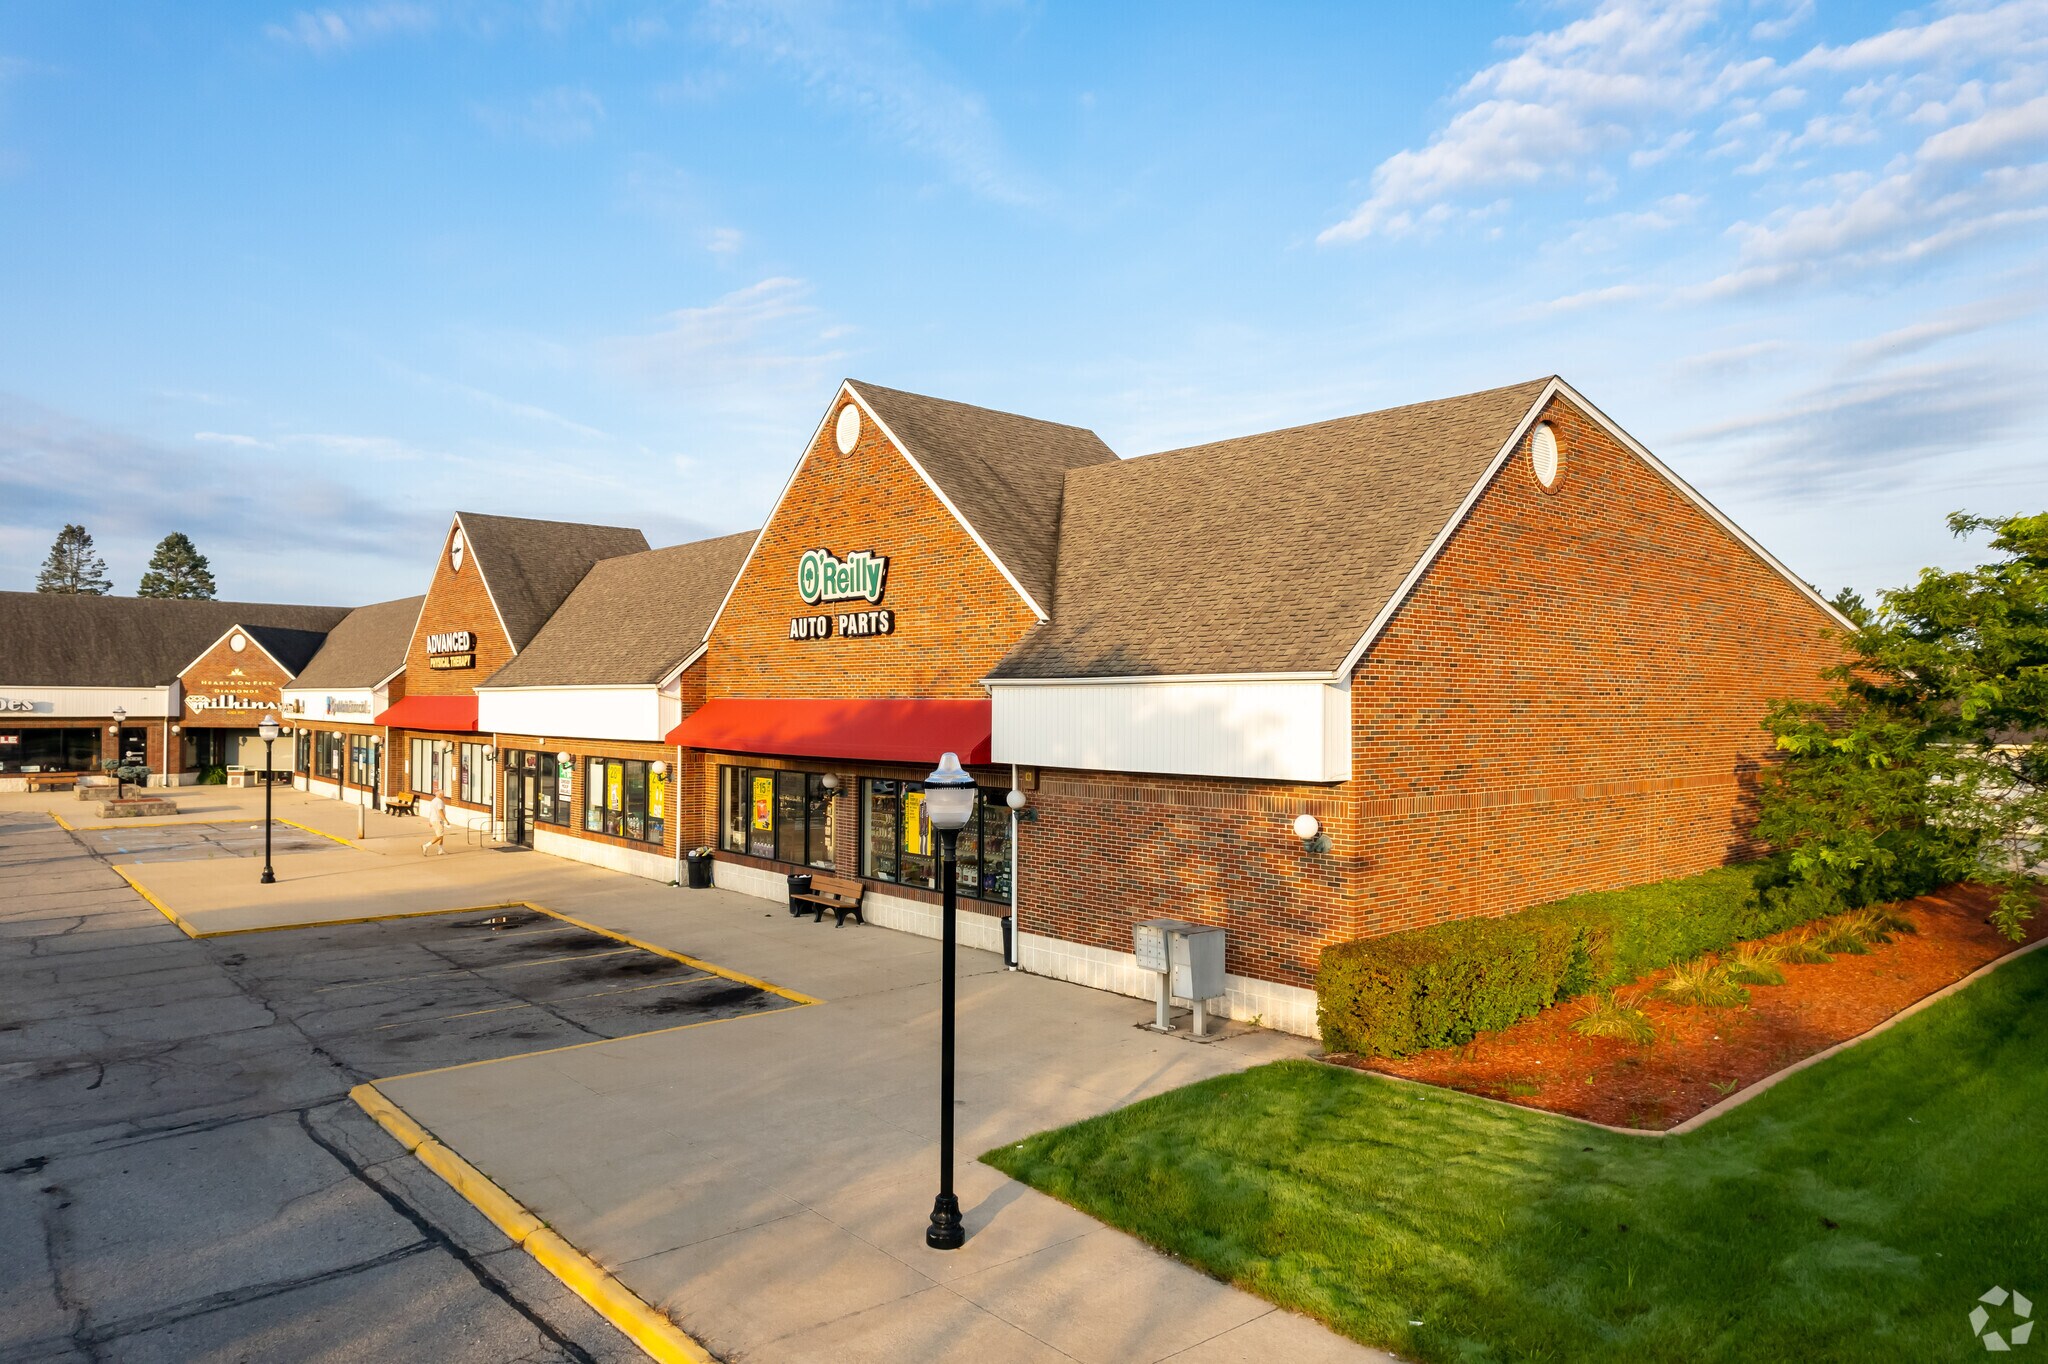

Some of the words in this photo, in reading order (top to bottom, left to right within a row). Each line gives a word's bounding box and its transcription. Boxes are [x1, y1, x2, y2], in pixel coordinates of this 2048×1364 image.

[800, 553, 881, 599] O'Reilly
[789, 616, 827, 639] AUTO
[838, 610, 889, 636] PARTS
[426, 631, 470, 654] ADVANCED
[450, 655, 471, 667] THERAPY
